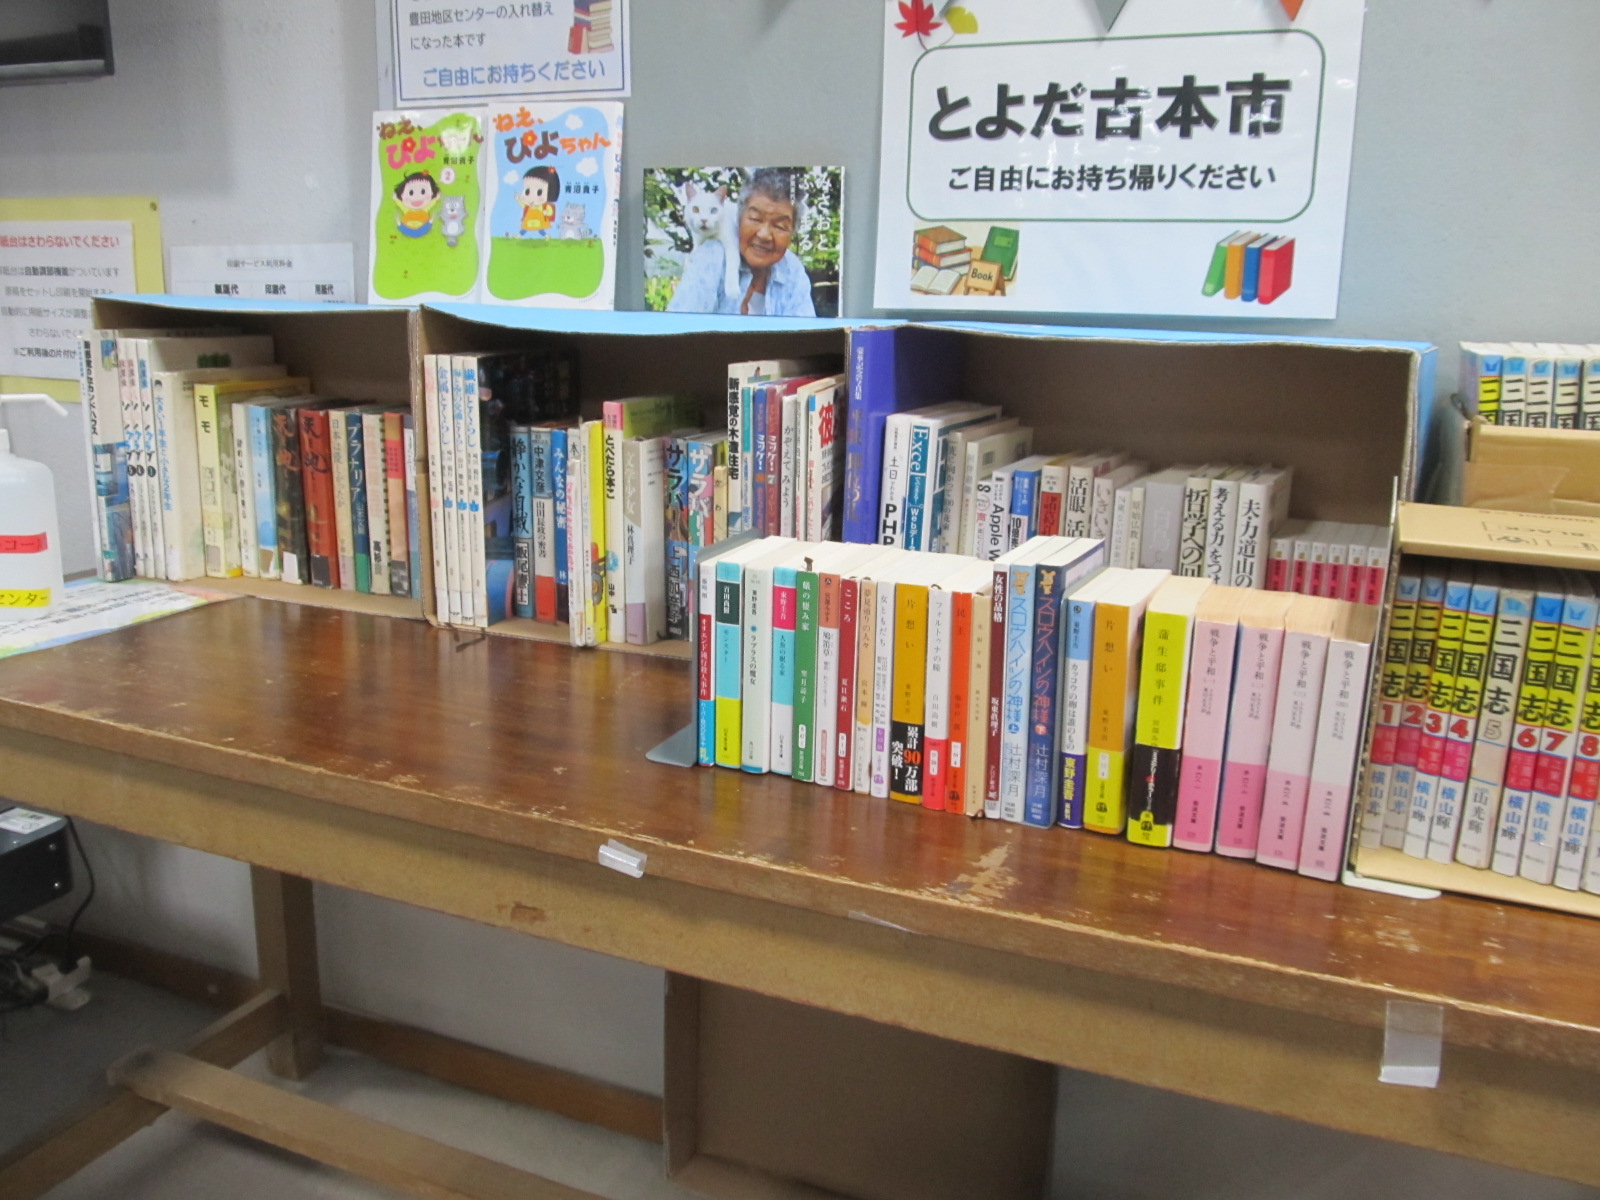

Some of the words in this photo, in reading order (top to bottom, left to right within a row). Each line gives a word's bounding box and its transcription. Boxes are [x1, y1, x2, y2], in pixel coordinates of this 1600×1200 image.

[409, 2, 554, 26] 豊田地区センターの入れ替え
[410, 34, 486, 50] になった本です
[424, 60, 605, 87] ご自由にお持ちください
[928, 73, 1292, 141] とよだ古本市
[505, 130, 611, 163] ぴよちゃん
[949, 164, 1275, 193] ご自由にお持ち帰りください
[799, 174, 813, 255] ふくまる
[817, 174, 833, 255] みさおと
[971, 268, 994, 283] Book
[199, 395, 210, 434] モモ
[728, 378, 739, 480] 新感覚の木造住宅
[348, 424, 363, 502] プラナリア
[910, 426, 929, 477] Excel
[553, 447, 566, 528] みんなの秘密
[1069, 477, 1088, 514] 活眼
[990, 504, 1005, 546] Apple
[843, 588, 853, 624] こころ
[879, 594, 888, 648] 女ともだち
[993, 574, 1004, 623] 女性の品格
[904, 599, 916, 650] 片想い
[932, 601, 943, 672] フォルトゥナの瞳
[1103, 619, 1115, 673] 片想い
[1382, 603, 1414, 697] 三国志
[1406, 602, 1438, 698] 三国志
[749, 635, 758, 686] ラプラスの魔女
[1007, 597, 1028, 724] スロウハイツの神様
[1032, 597, 1055, 724] スロウハイツの神様
[1152, 628, 1170, 706] 蒲生邸事件
[1206, 629, 1220, 676] 戦争と平和
[1254, 633, 1269, 681] 戦争と平和
[1296, 640, 1311, 689] 戦争と平和
[1338, 650, 1354, 699] 戦争と平和
[1430, 612, 1463, 712] 三国志
[1452, 617, 1489, 716] 三国志
[1483, 622, 1521, 721] 三国志
[1520, 629, 1556, 726] 三国志
[1544, 632, 1582, 731] 三国志
[1066, 663, 1079, 755] カッコウの卵は誰のもの
[1382, 703, 1394, 723] 1
[1402, 703, 1421, 726] 2
[1425, 718, 1443, 739] 3
[1450, 724, 1469, 745] 4
[903, 725, 920, 796] 累計90万部
[1484, 725, 1501, 745] 5
[1517, 732, 1536, 752] 6
[1541, 736, 1565, 756] 7
[1580, 735, 1599, 756] 8
[1007, 743, 1022, 798] 辻村深月
[1034, 743, 1049, 799] 辻村深月
[1063, 757, 1075, 801] 東野圭吾
[1468, 787, 1488, 834] 山光輝
